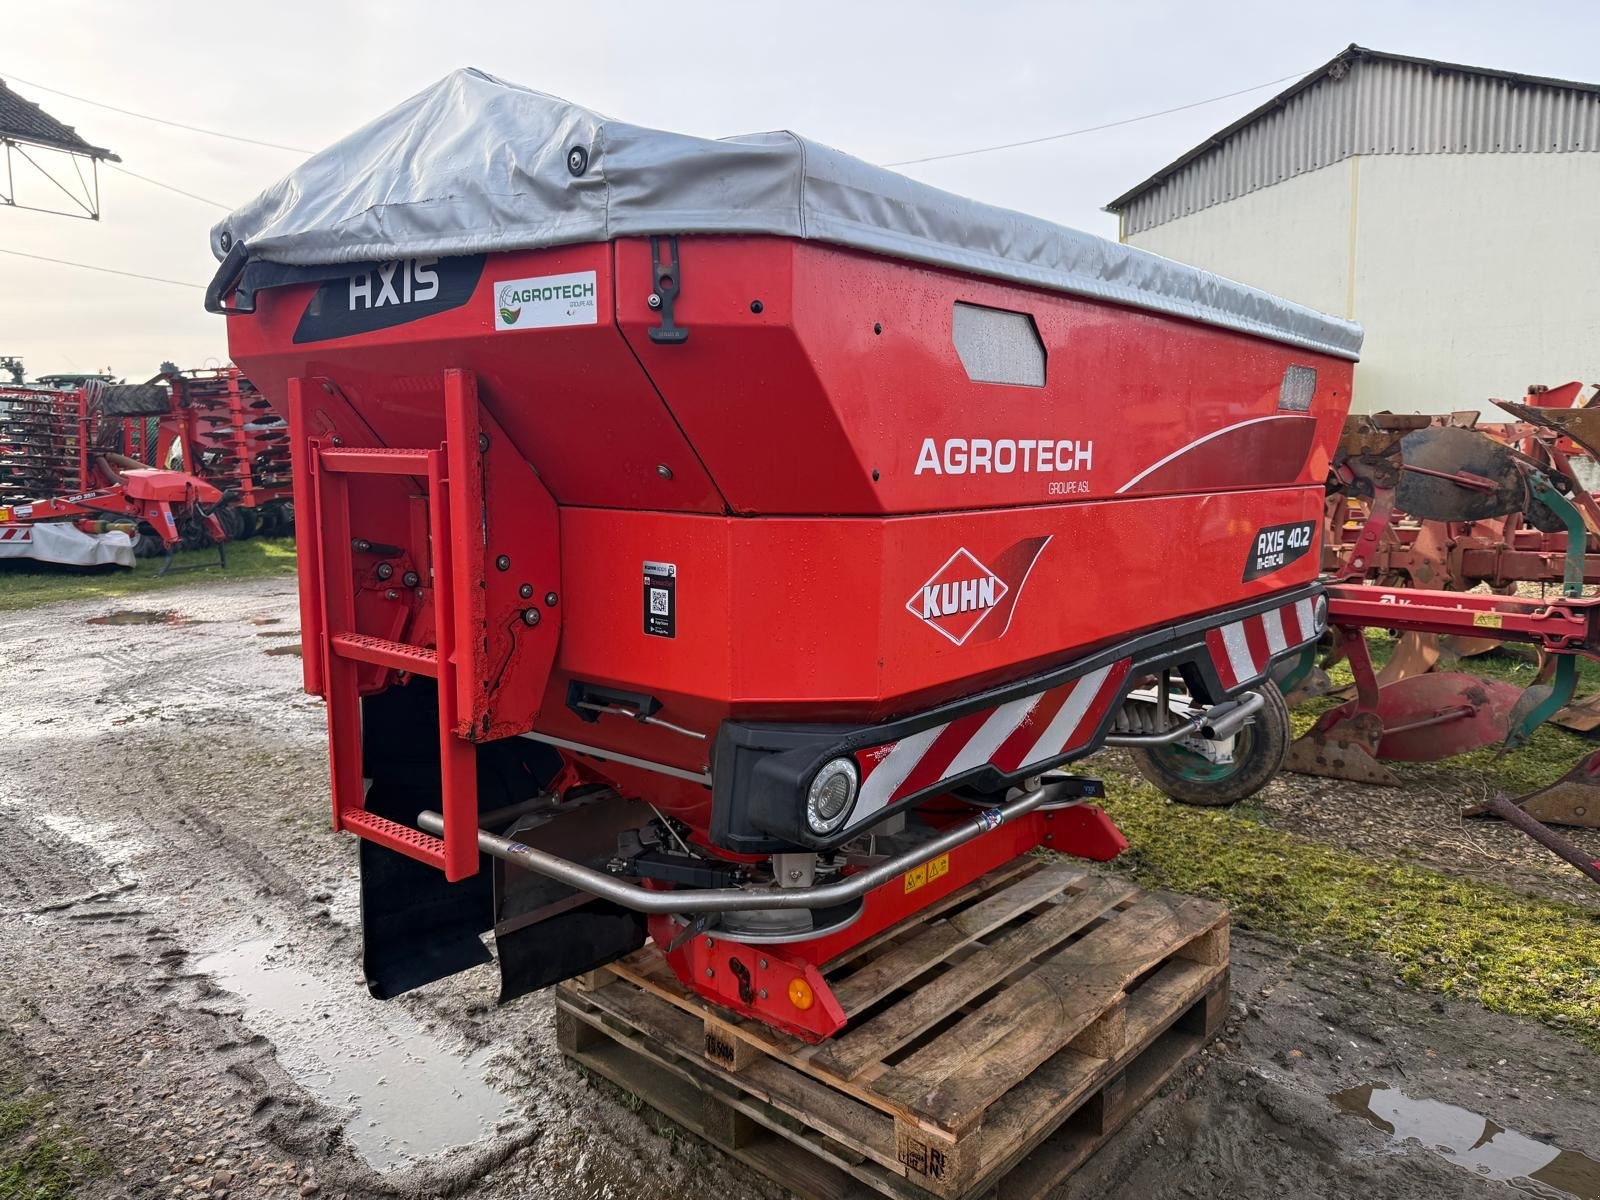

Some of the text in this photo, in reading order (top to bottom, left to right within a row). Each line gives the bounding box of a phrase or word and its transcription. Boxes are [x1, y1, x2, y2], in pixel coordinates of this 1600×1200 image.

[349, 258, 439, 311] AXIS
[511, 282, 594, 304] AGROTECH
[914, 437, 1093, 476] AGROTECH
[1048, 480, 1091, 495] GROUPE ASL
[1257, 526, 1310, 556] AXIS 40.2
[923, 576, 995, 620] KUHN
